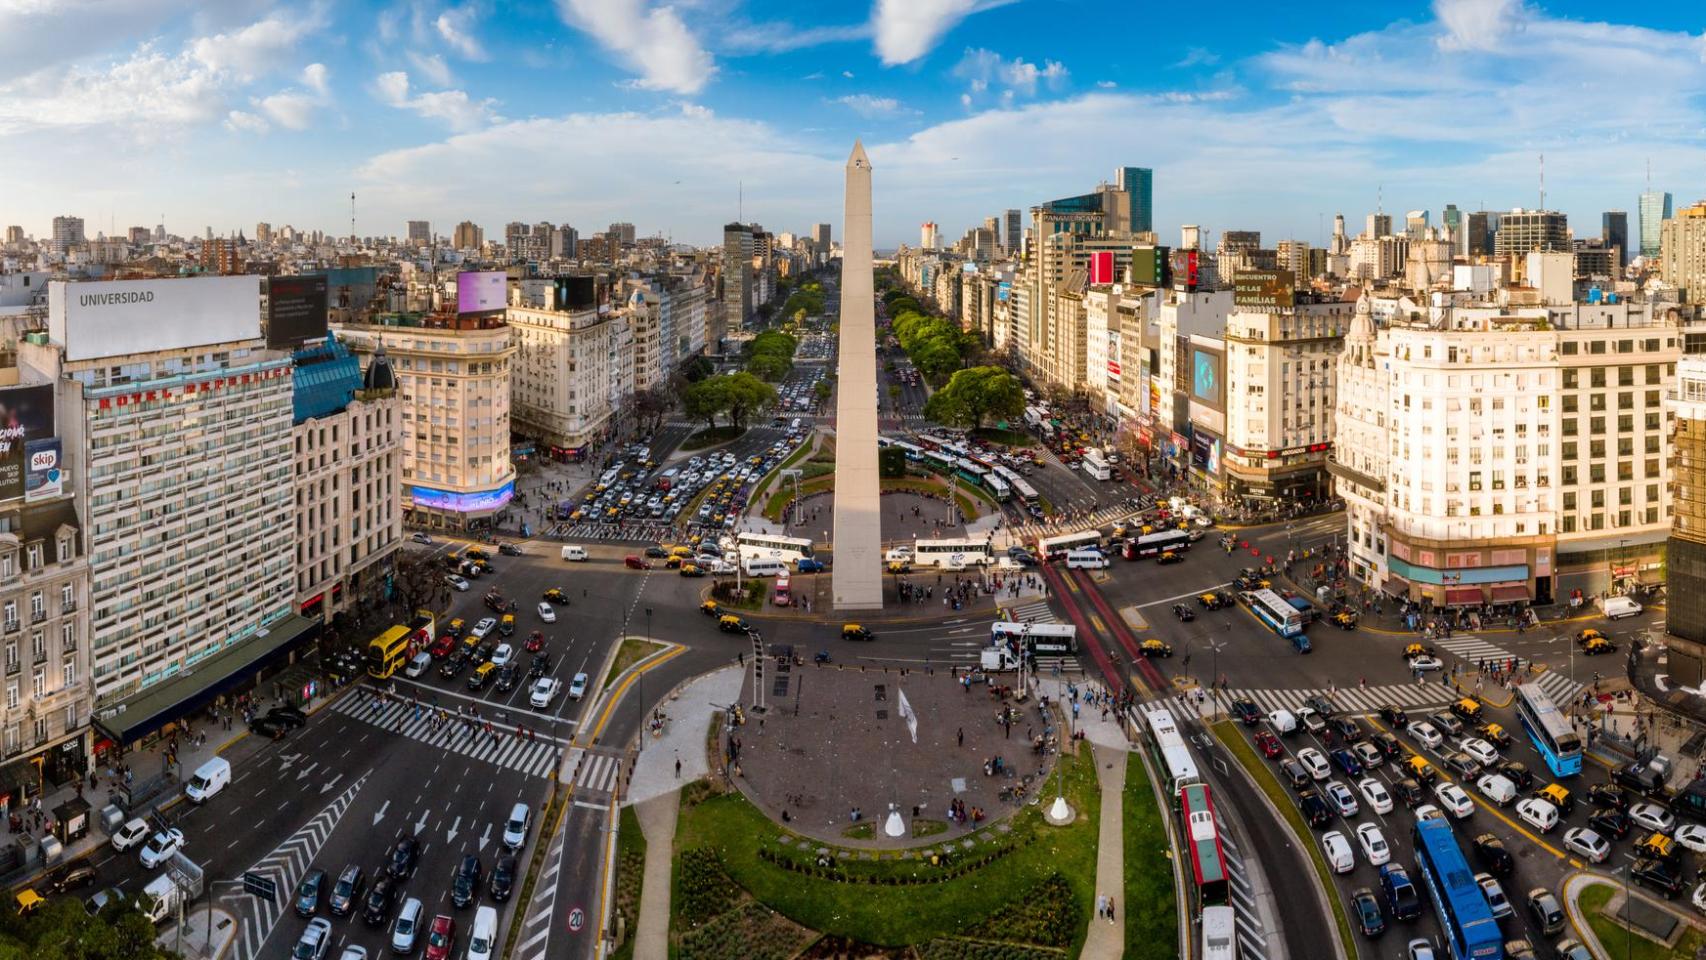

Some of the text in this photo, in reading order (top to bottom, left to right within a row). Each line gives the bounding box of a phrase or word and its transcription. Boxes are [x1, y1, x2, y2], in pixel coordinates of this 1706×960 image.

[80, 291, 154, 307] UNIVERSIDAD
[34, 453, 54, 466] skip
[571, 912, 582, 927] 20
